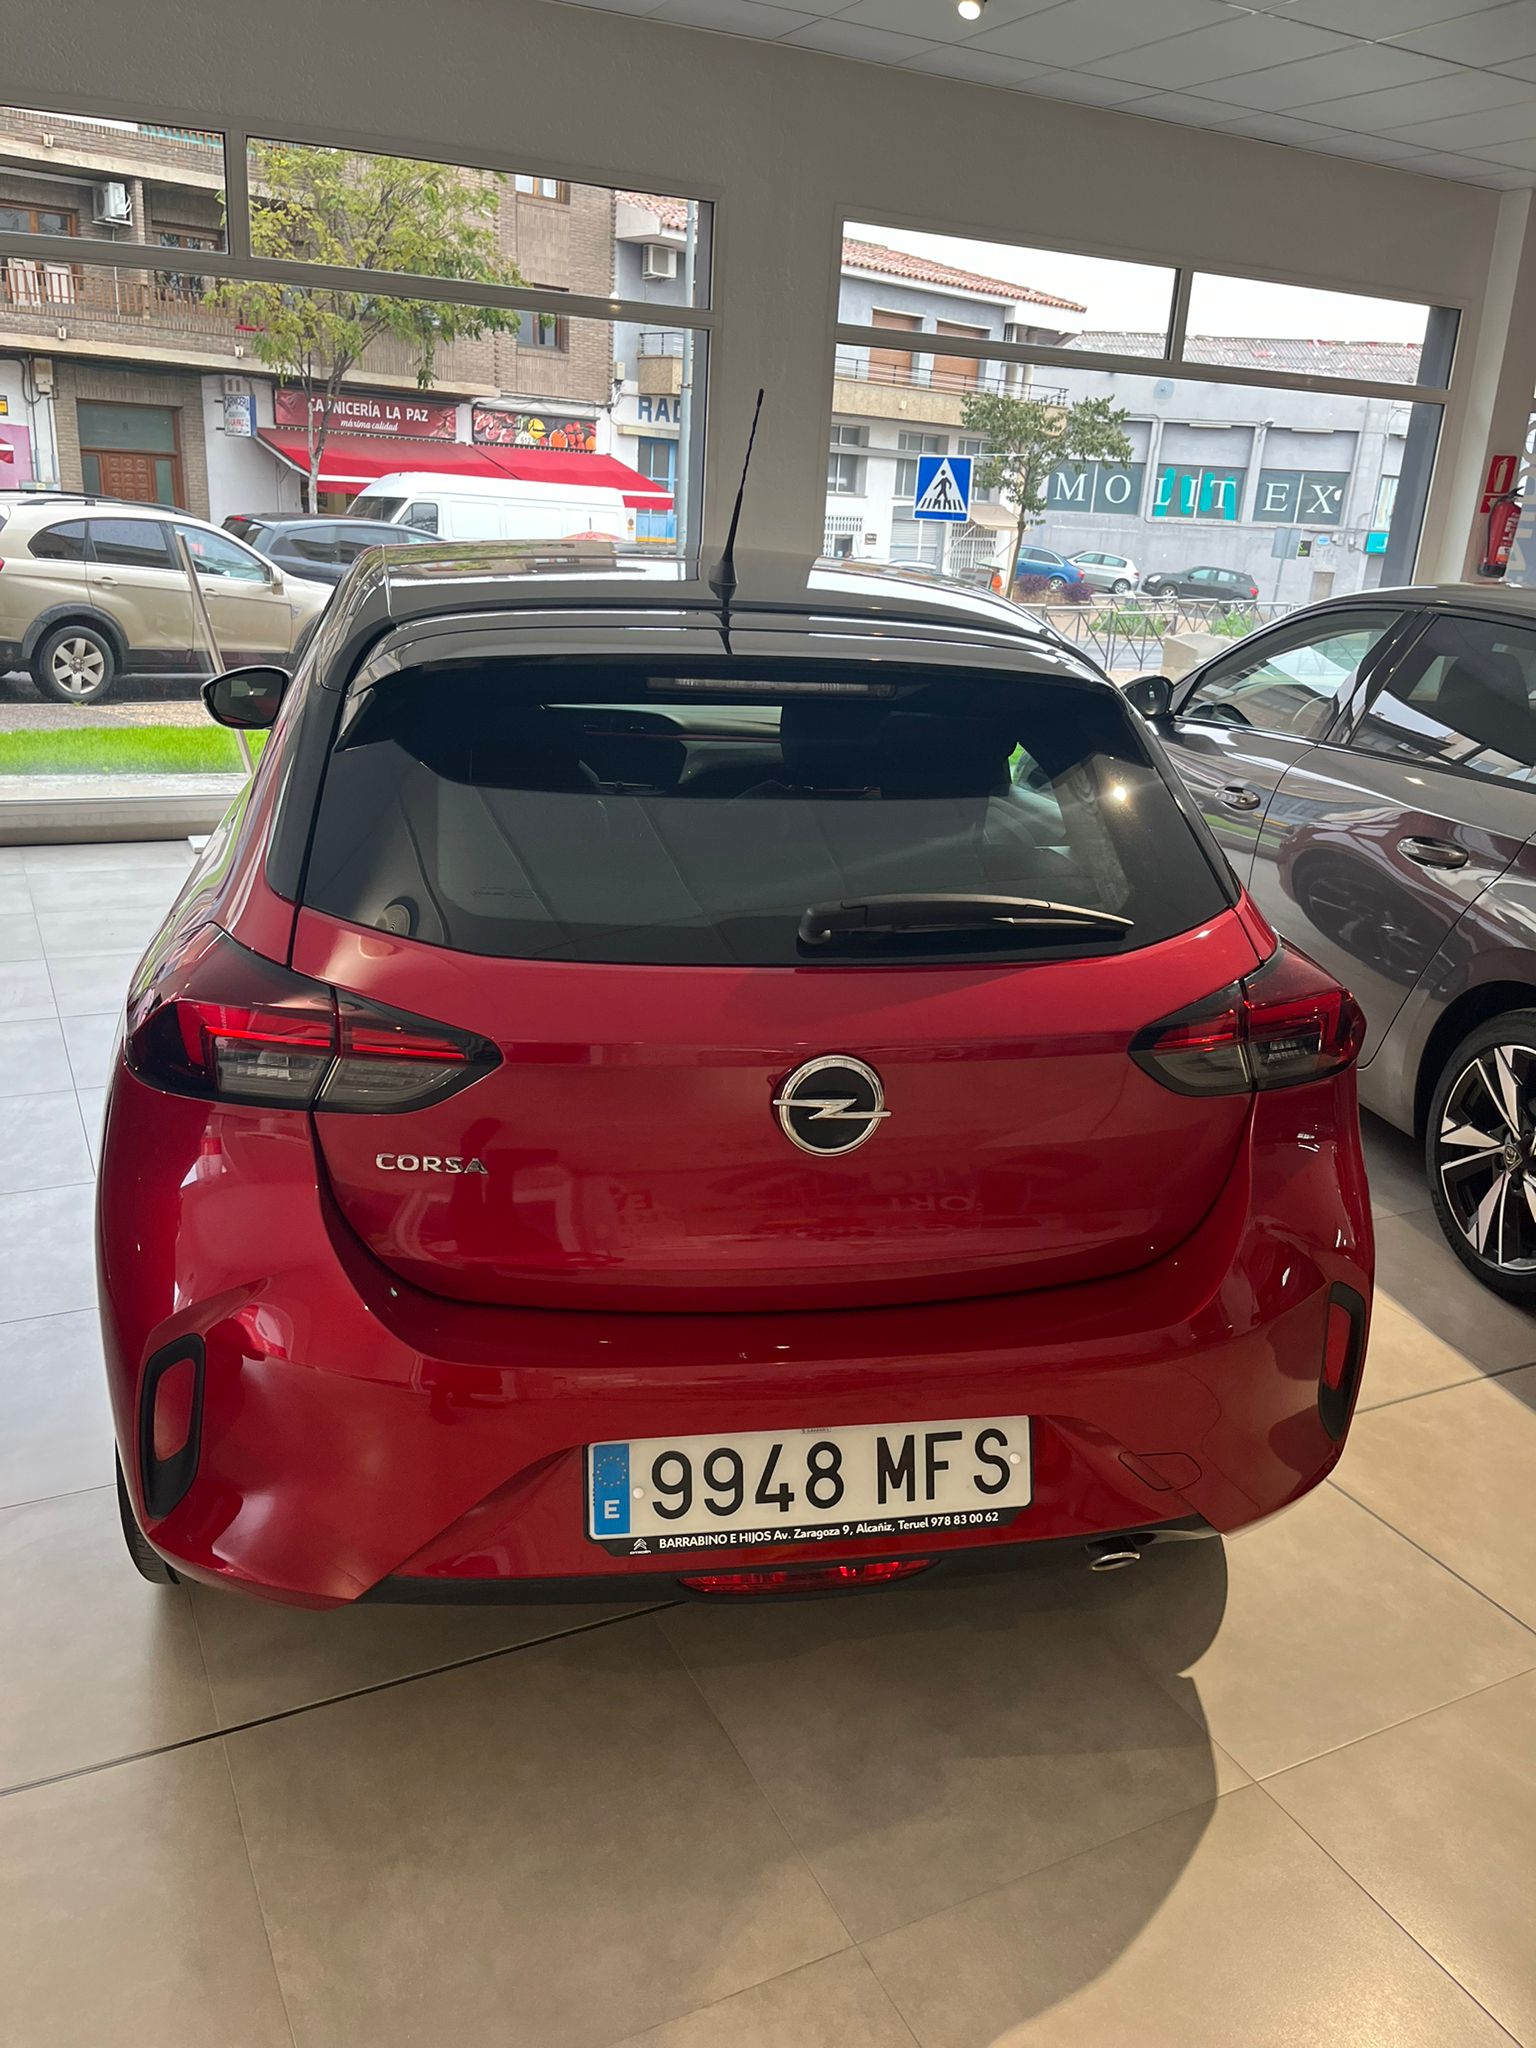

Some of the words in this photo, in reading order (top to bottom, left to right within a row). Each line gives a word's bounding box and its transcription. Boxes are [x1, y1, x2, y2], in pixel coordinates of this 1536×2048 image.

[308, 398, 381, 418] CANICERÍA
[386, 406, 401, 420] LA
[406, 408, 429, 422] PAZ
[375, 1153, 489, 1175] CORSA
[652, 1441, 845, 1519] 9948
[877, 1428, 1010, 1504] MFS
[604, 1499, 620, 1519] E
[659, 1533, 728, 1548] BARRABINO
[729, 1533, 737, 1544] E
[739, 1531, 771, 1543] HIJOS
[773, 1530, 791, 1541] Av.
[793, 1528, 840, 1540] Zaragoza
[842, 1525, 854, 1536] 9,
[856, 1522, 896, 1534] Alcañiz,
[898, 1517, 929, 1530] Teruel
[930, 1516, 951, 1527] 978
[954, 1514, 967, 1525] 83
[969, 1513, 983, 1523] 00
[985, 1512, 999, 1522] 62
